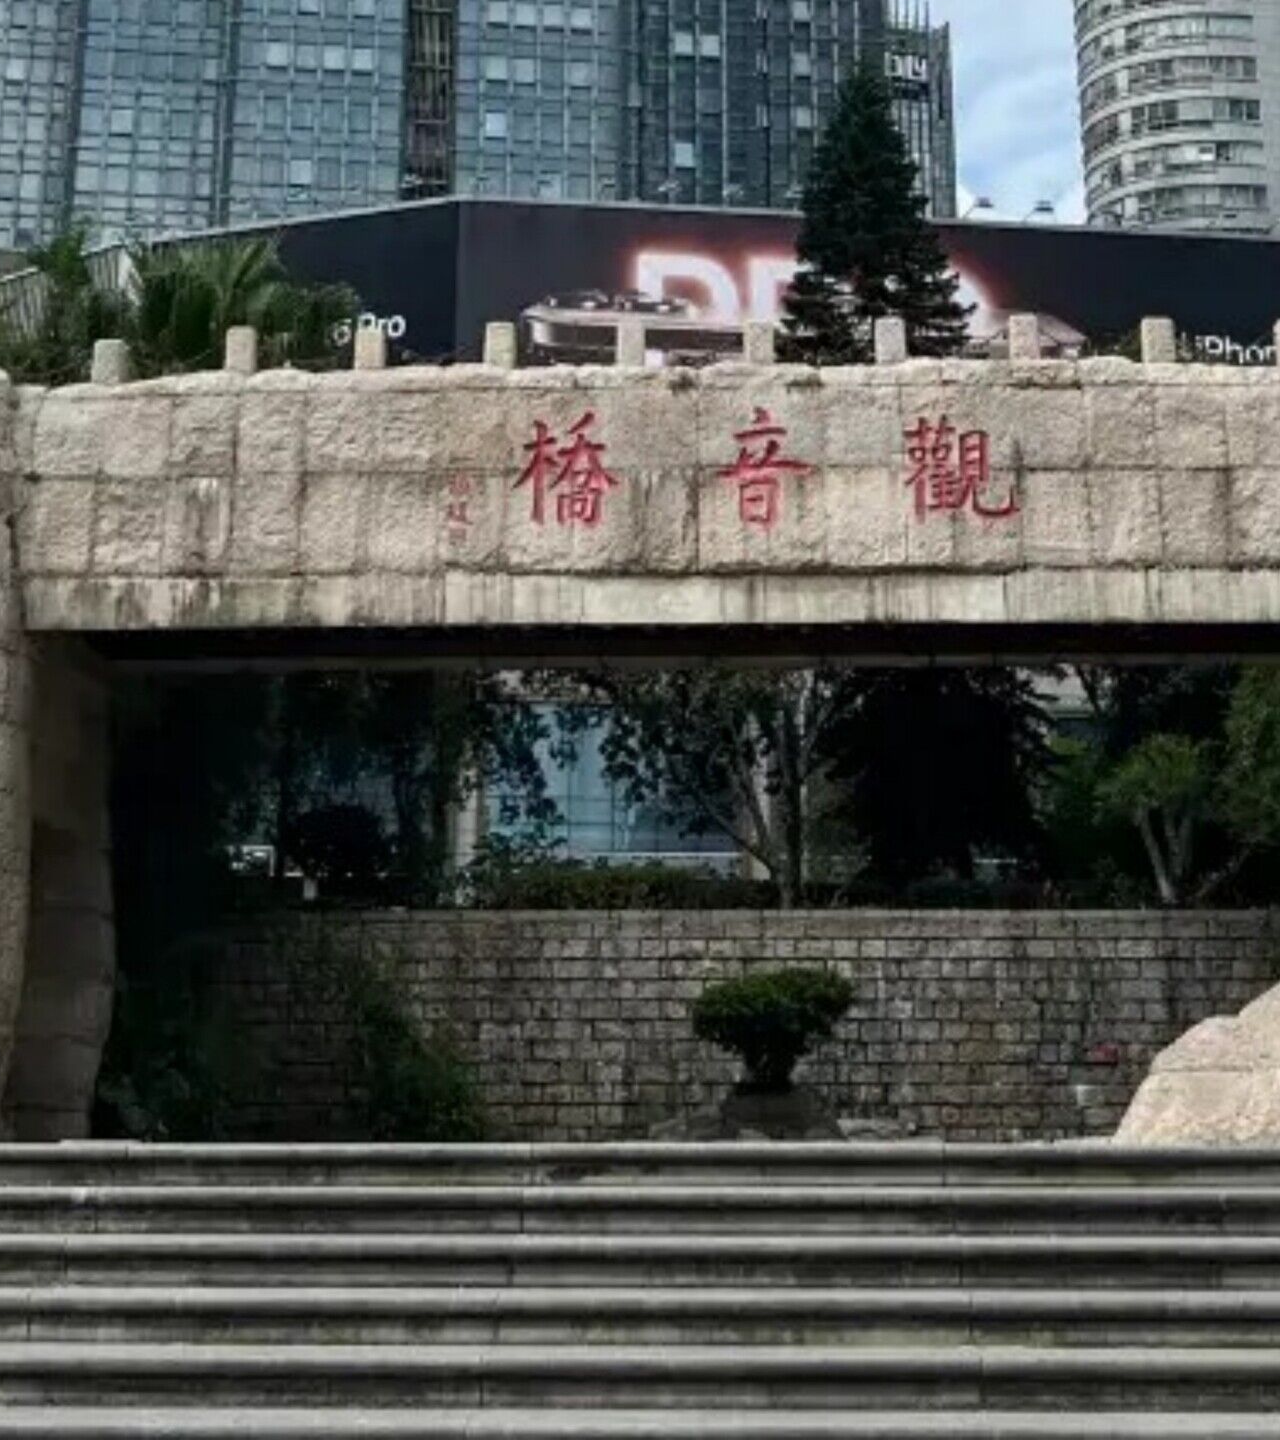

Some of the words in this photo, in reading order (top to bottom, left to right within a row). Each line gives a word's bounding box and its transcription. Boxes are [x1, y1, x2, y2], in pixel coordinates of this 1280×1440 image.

[1195, 333, 1278, 364] iPhon
[512, 406, 1022, 527] 觀音橋
